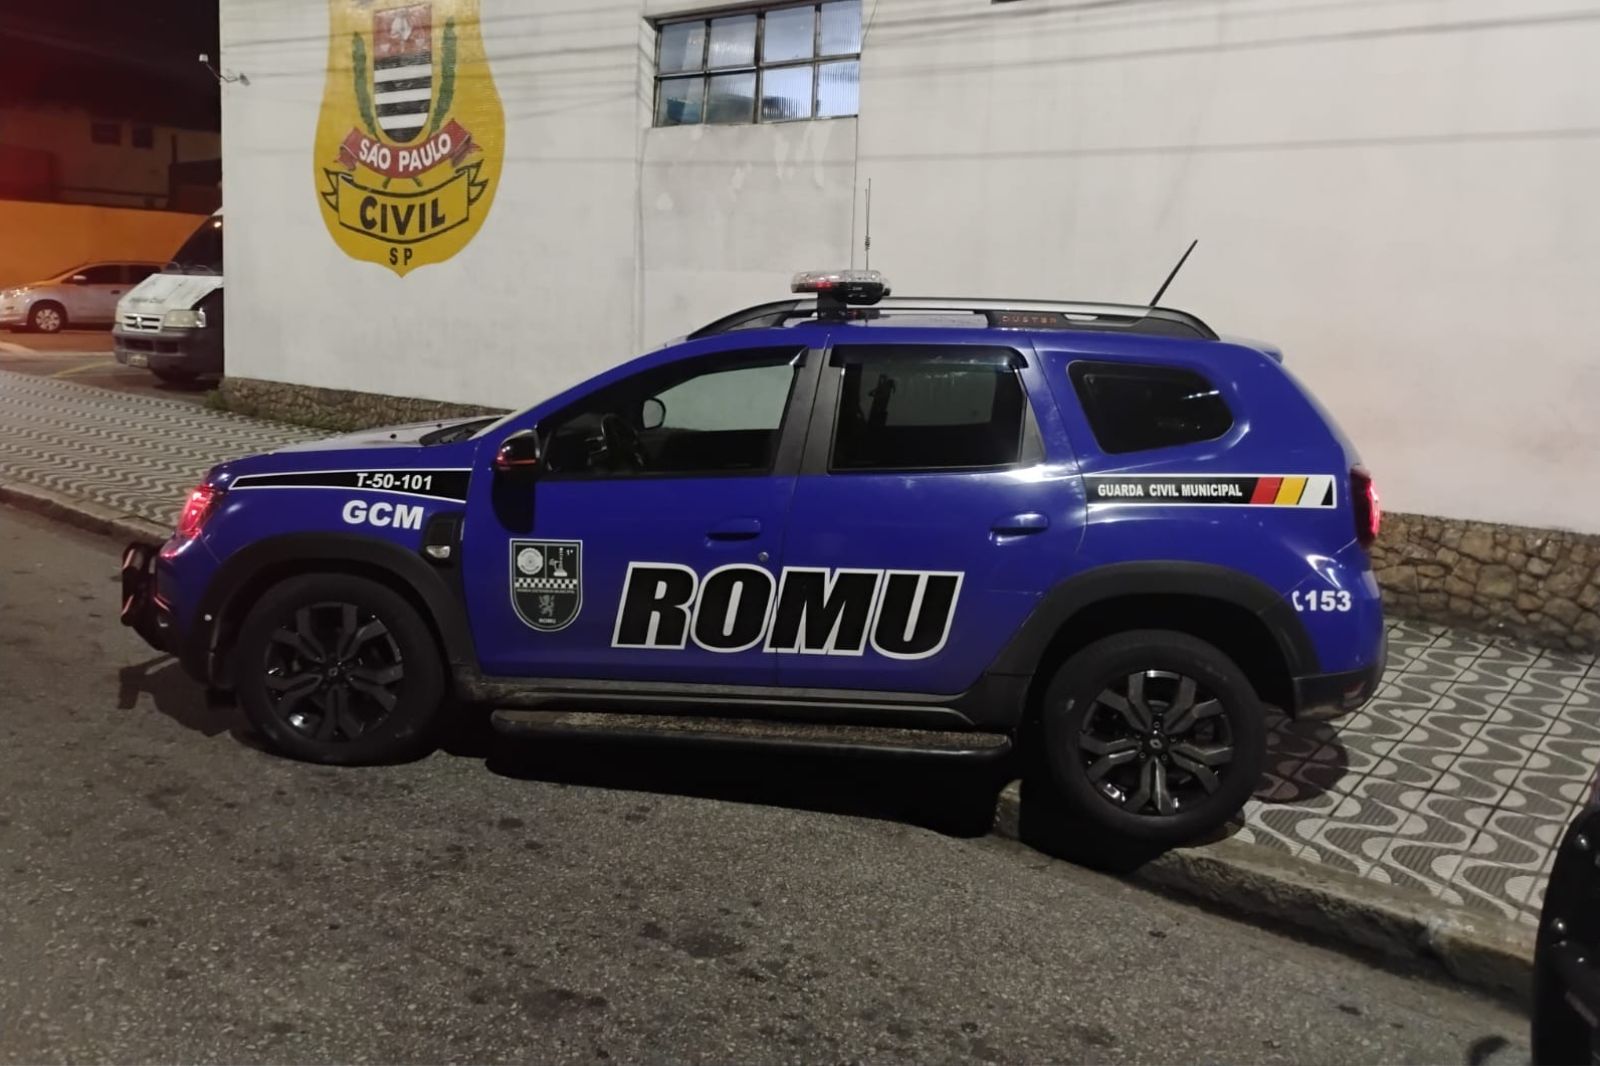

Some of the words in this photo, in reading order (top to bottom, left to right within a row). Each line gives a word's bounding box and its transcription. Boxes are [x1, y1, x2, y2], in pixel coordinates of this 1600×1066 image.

[398, 133, 452, 172] PAULO
[360, 195, 446, 235] CIVIL
[356, 472, 433, 491] T-50-101
[1097, 484, 1144, 497] GUARDA
[1149, 484, 1179, 497] CIVIL
[1181, 484, 1243, 497] MUNICIPAL
[342, 499, 425, 531] GCM
[611, 561, 965, 660] ROMU
[1304, 589, 1352, 612] 153
